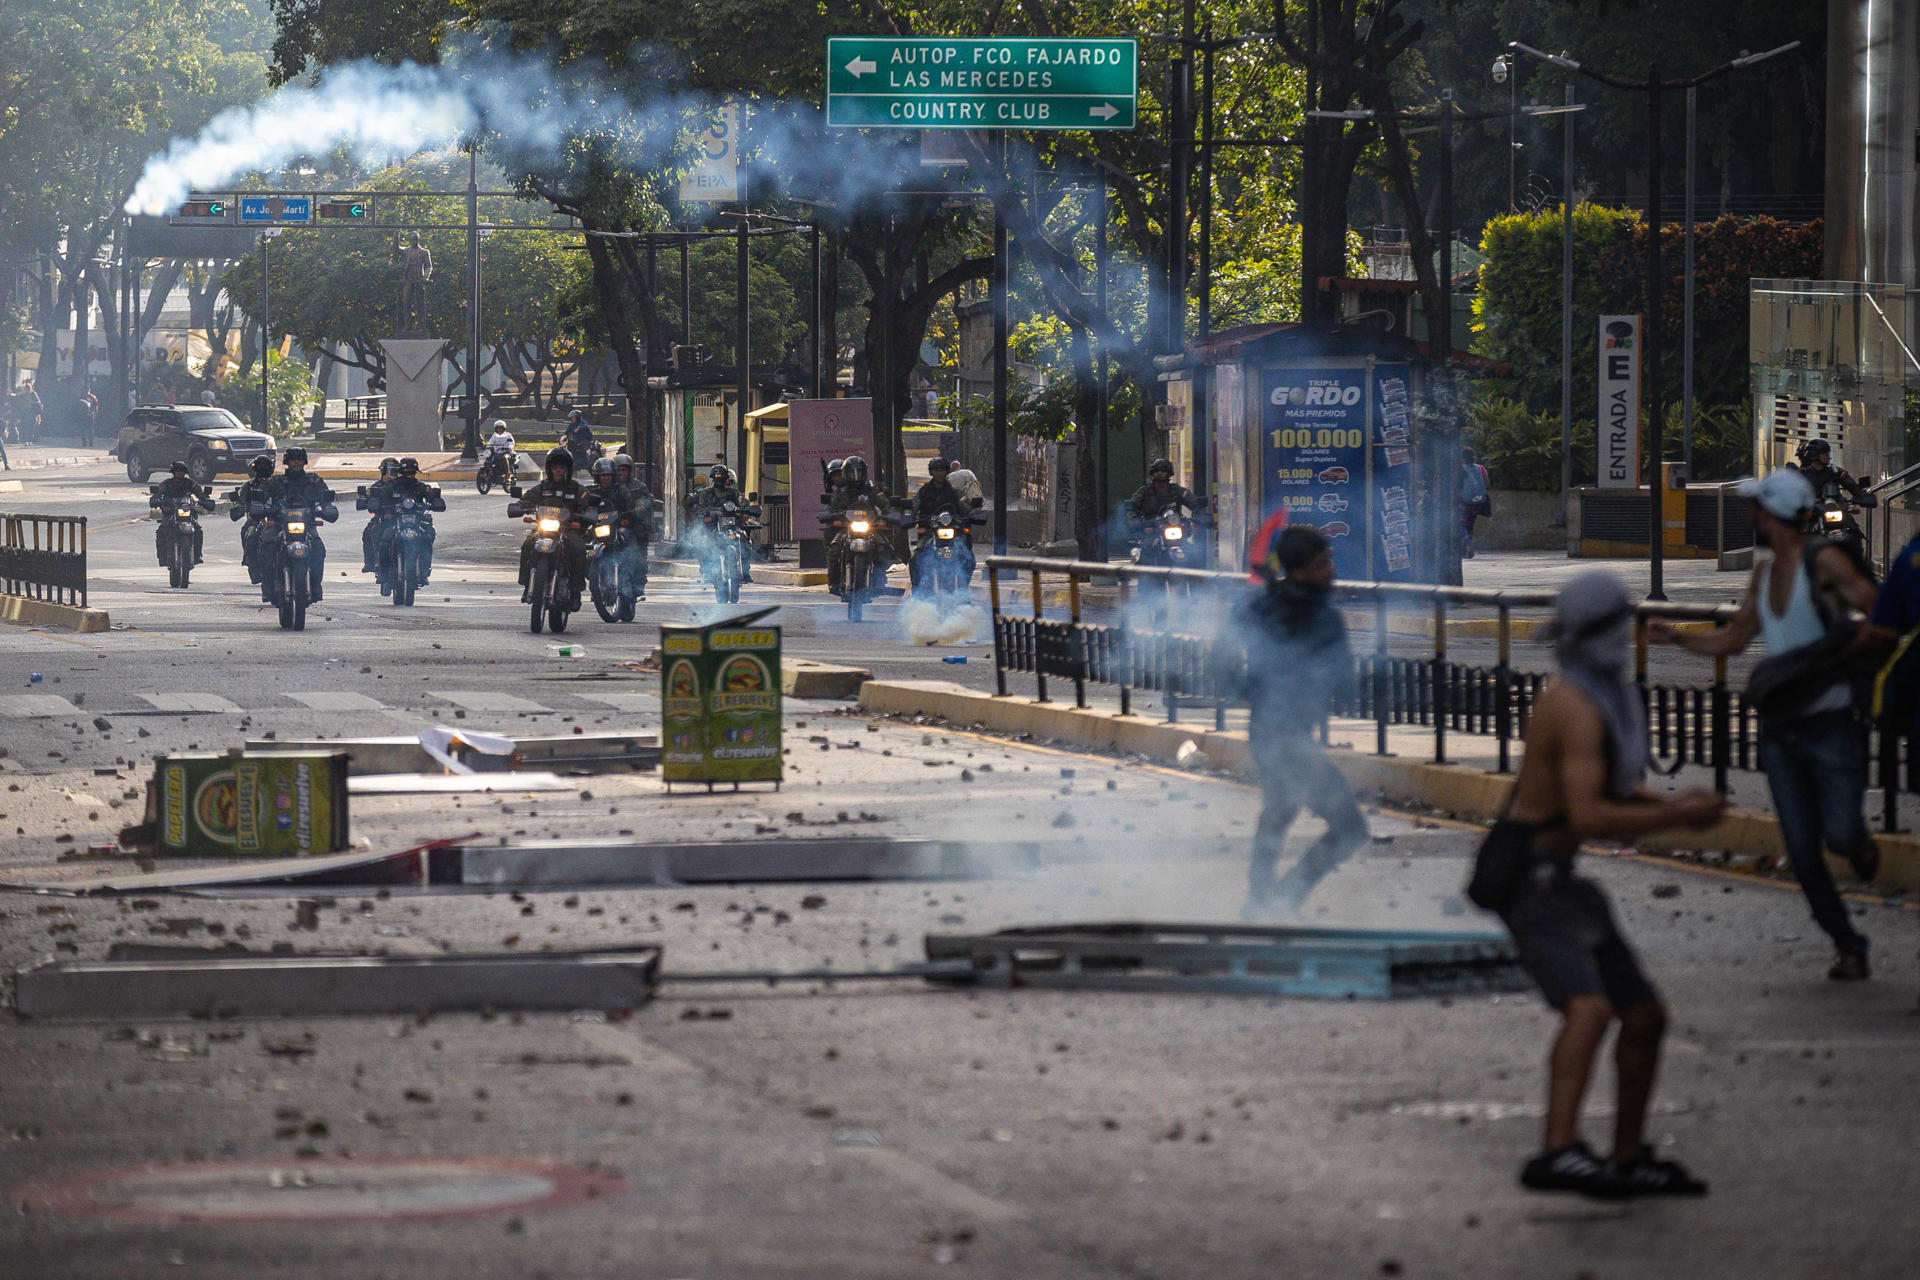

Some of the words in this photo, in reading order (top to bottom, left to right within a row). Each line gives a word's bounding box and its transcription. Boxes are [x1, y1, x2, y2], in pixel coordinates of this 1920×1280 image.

[890, 47, 964, 65] AUTOP.
[973, 47, 1018, 65] FCO.
[1027, 48, 1122, 65] FAJARDO
[889, 71, 931, 87] LAS
[940, 71, 1053, 88] MERCEDES
[890, 102, 986, 119] COUNTRY
[998, 103, 1050, 119] CLUB
[697, 175, 728, 188] EPA
[282, 204, 305, 214] Martí
[1608, 355, 1630, 380] E
[1285, 407, 1304, 417] MÁS
[1306, 409, 1347, 417] PREMIOS
[1270, 429, 1362, 448] 100.000
[1610, 389, 1627, 480] ENTRADA
[1283, 495, 1313, 506] 9.000
[712, 632, 775, 646] PAPELERA
[169, 769, 182, 844] PAPELERA
[240, 766, 256, 832] RESUELVE
